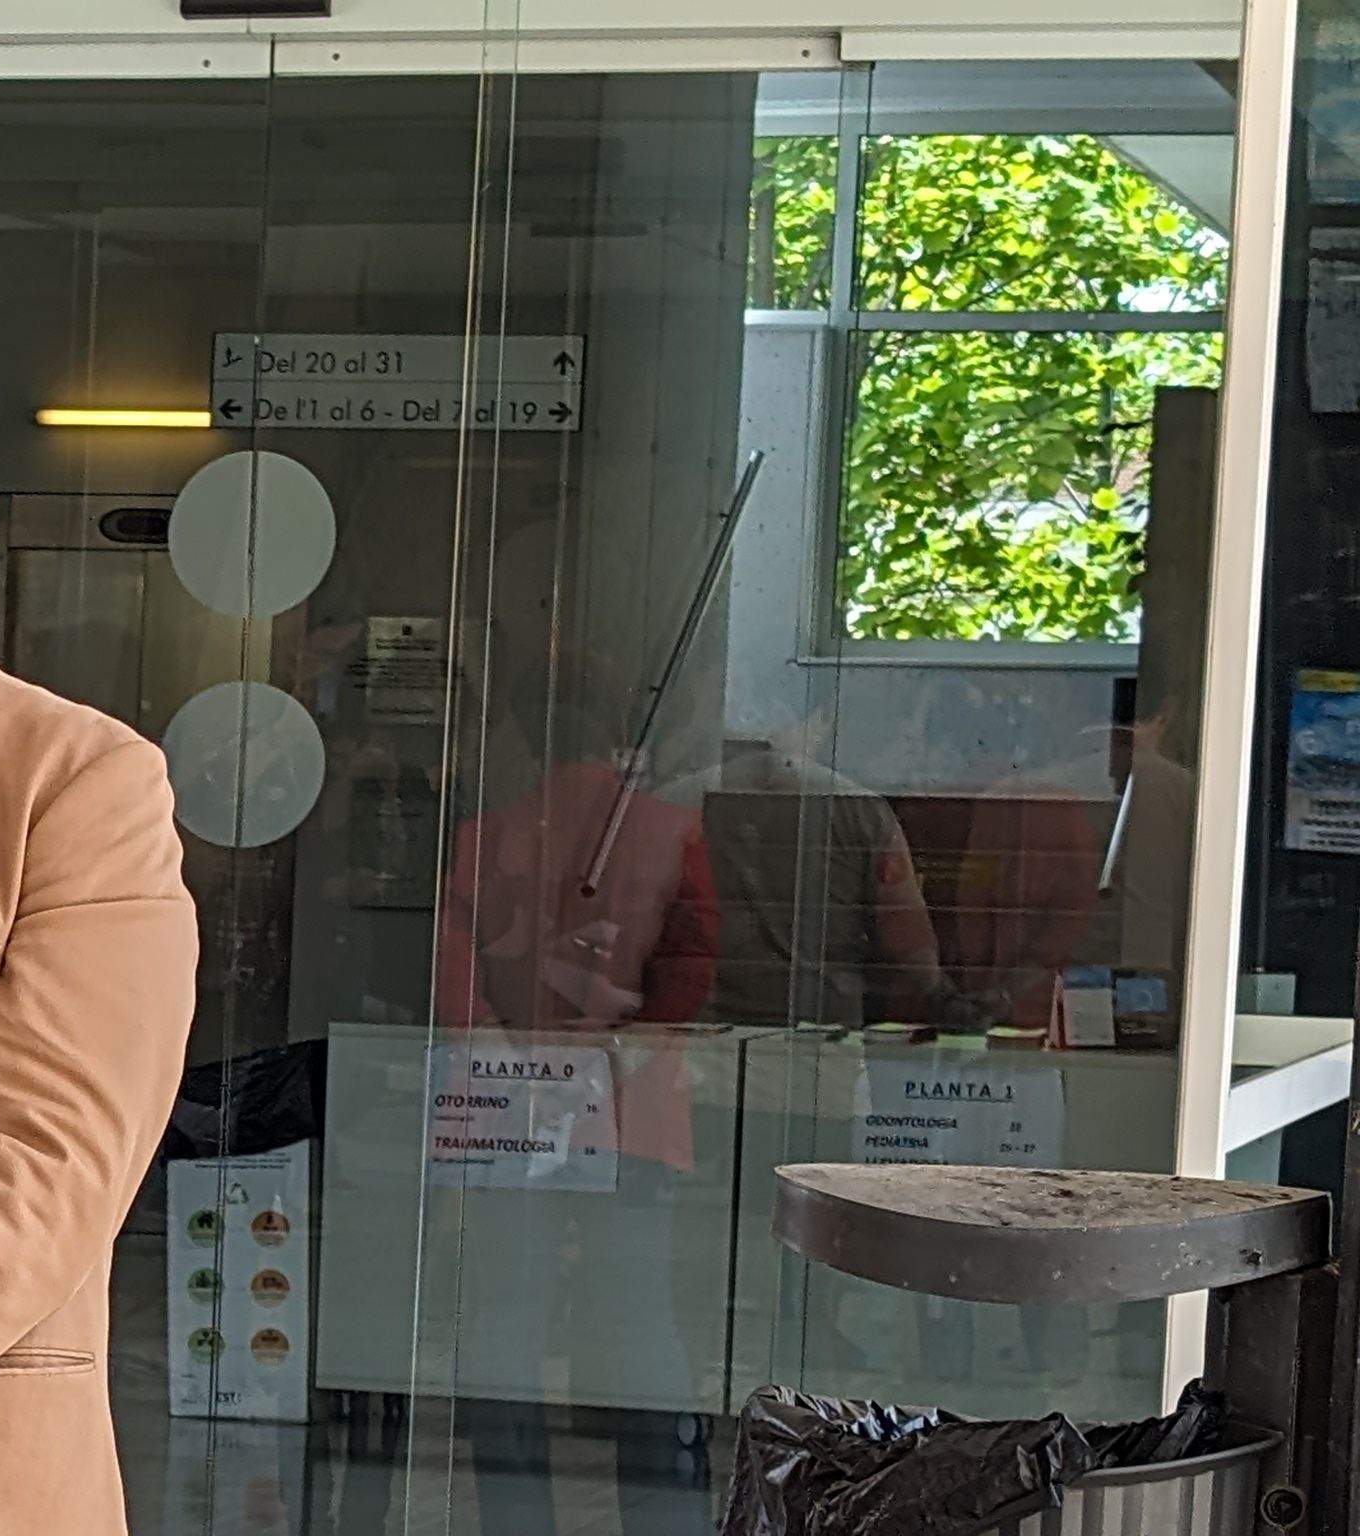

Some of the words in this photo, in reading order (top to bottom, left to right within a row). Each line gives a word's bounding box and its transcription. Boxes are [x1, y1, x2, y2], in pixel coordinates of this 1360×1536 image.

[257, 350, 297, 374] Del
[305, 351, 336, 374] 20
[344, 350, 367, 374] al
[375, 351, 403, 374] 31
[329, 397, 352, 421] al
[359, 400, 376, 422] 6
[402, 400, 440, 422] Del
[509, 401, 538, 424] 19
[472, 1061, 552, 1077] PLANTA
[563, 1063, 574, 1078] 0
[905, 1081, 992, 1098] PLANTA
